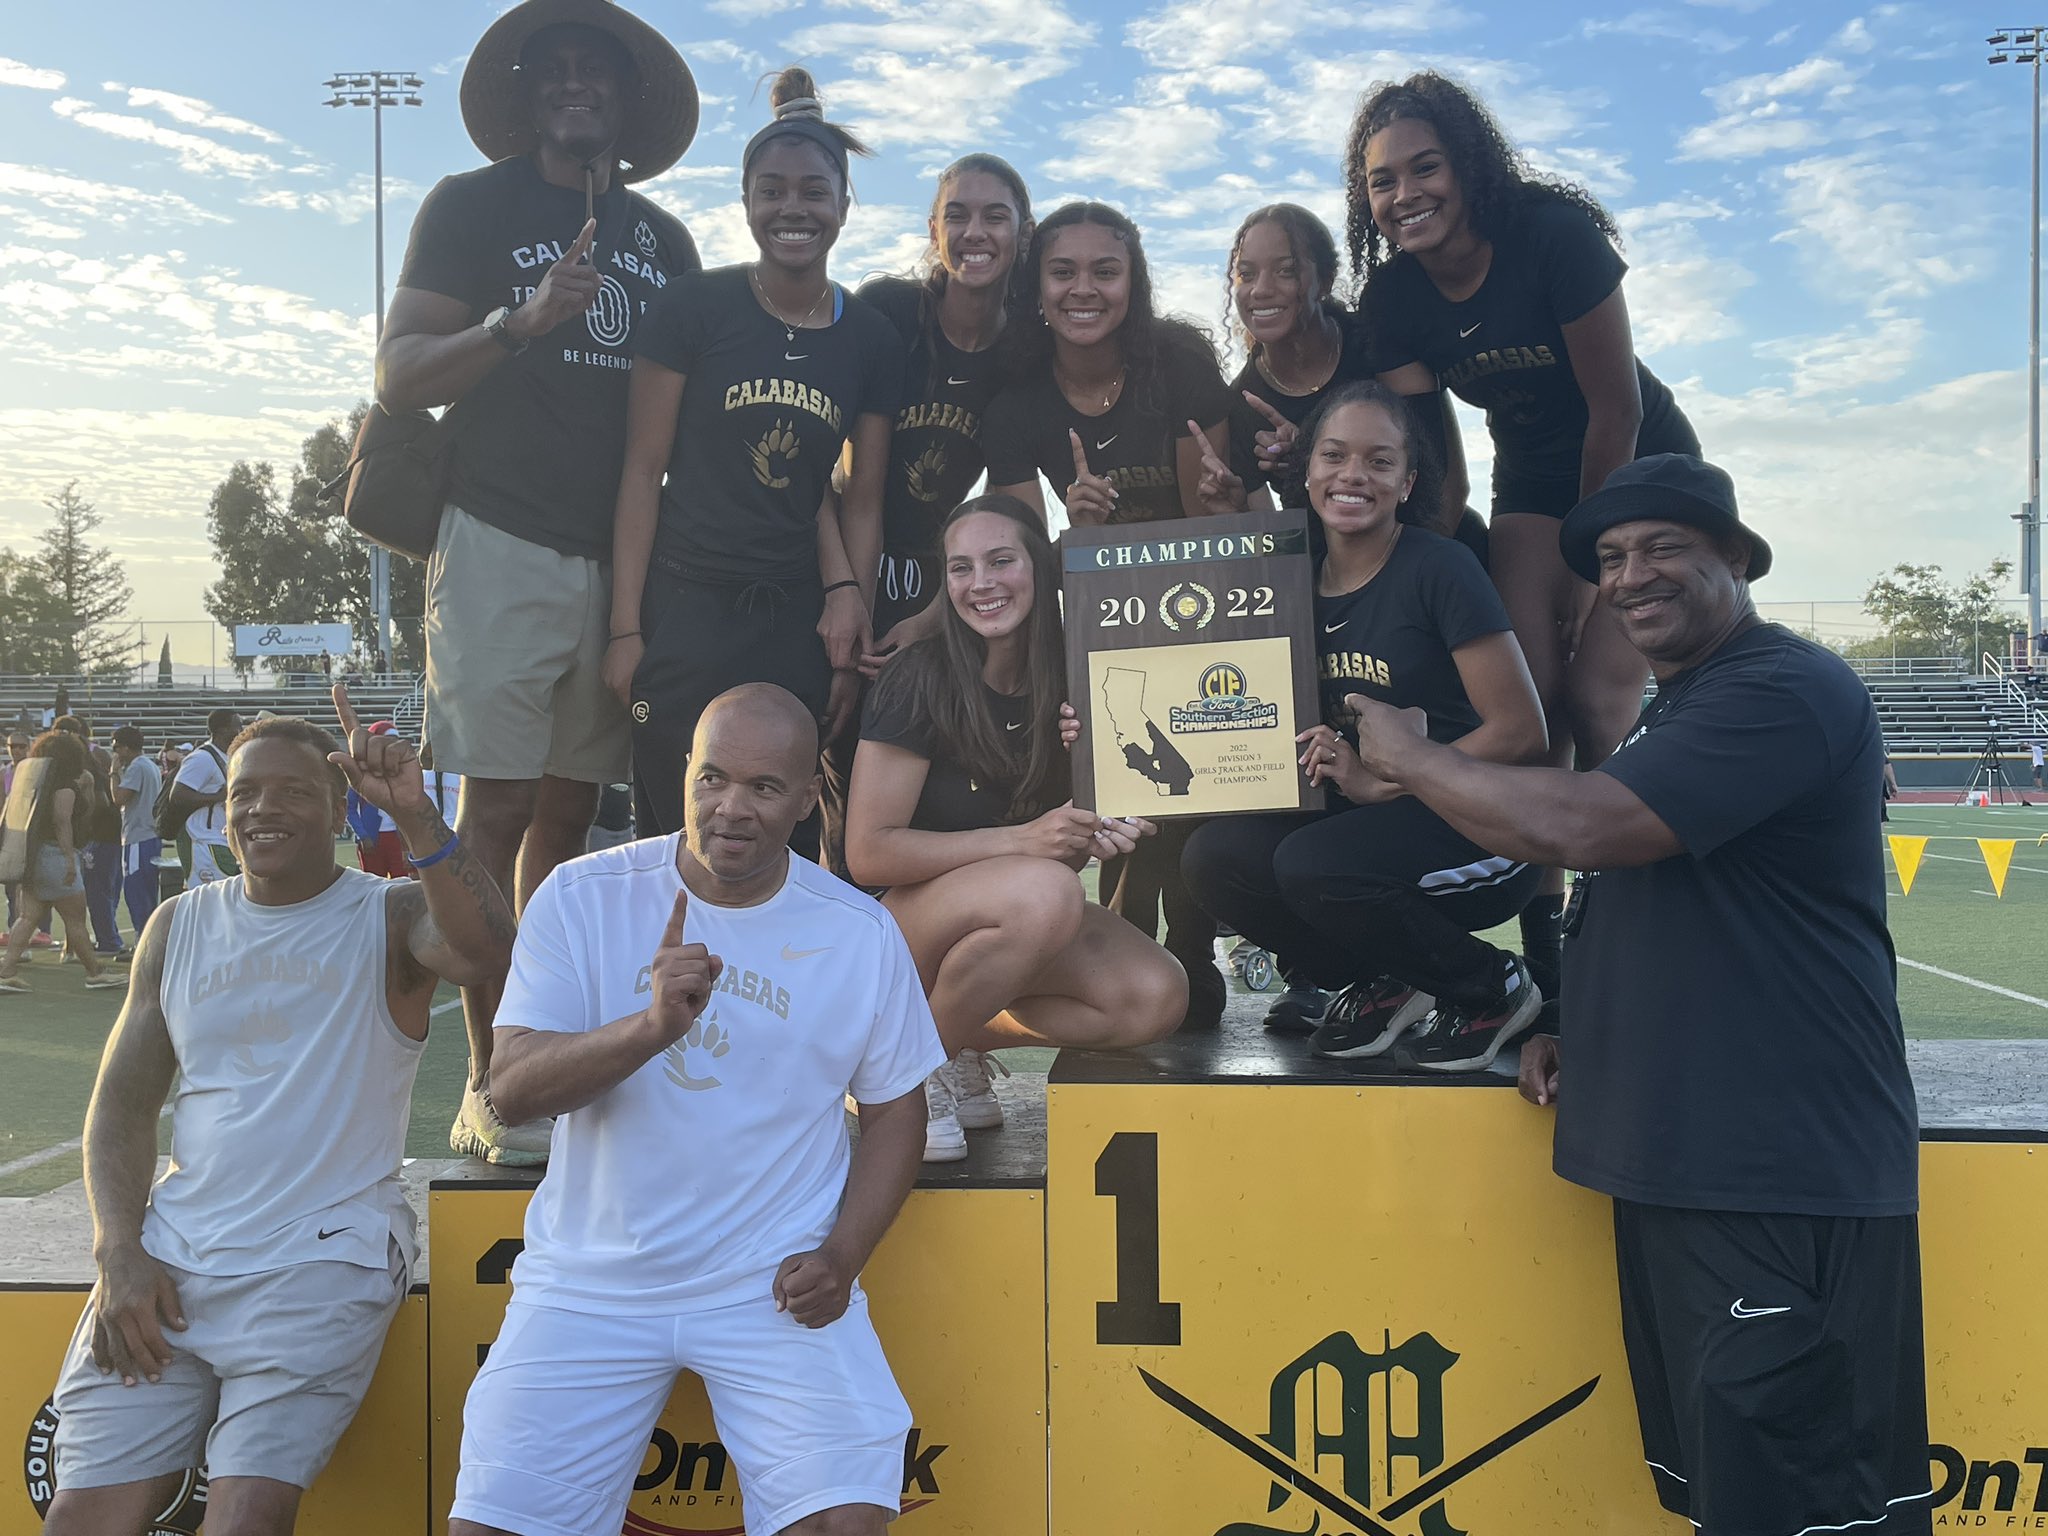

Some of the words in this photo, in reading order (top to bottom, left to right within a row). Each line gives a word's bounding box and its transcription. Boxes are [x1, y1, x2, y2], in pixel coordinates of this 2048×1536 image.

[564, 350, 579, 363] BE
[725, 378, 842, 434] CALABASAS
[1096, 534, 1275, 567] CHAMPIONS
[1100, 596, 1146, 627] 20
[1227, 586, 1275, 618] 22
[1205, 669, 1240, 698] CIF
[1209, 698, 1238, 710] Ford
[1171, 708, 1226, 721] Southern
[1231, 704, 1276, 720] Section
[1172, 715, 1276, 733] CHAMPIONSHIPS
[1230, 744, 1248, 752] 2022
[1218, 754, 1255, 763] DIVISION
[1257, 753, 1262, 761] 3
[1195, 767, 1217, 775] GIRLS
[1218, 765, 1244, 775] TRACK
[1245, 764, 1262, 773] AND
[1263, 763, 1285, 772] FIELD
[1213, 775, 1267, 785] CHAMPIONS
[192, 951, 343, 1005] CALABASAS
[1095, 1132, 1181, 1346] 1
[651, 1495, 698, 1506] AND
[1936, 1515, 1987, 1527] AND
